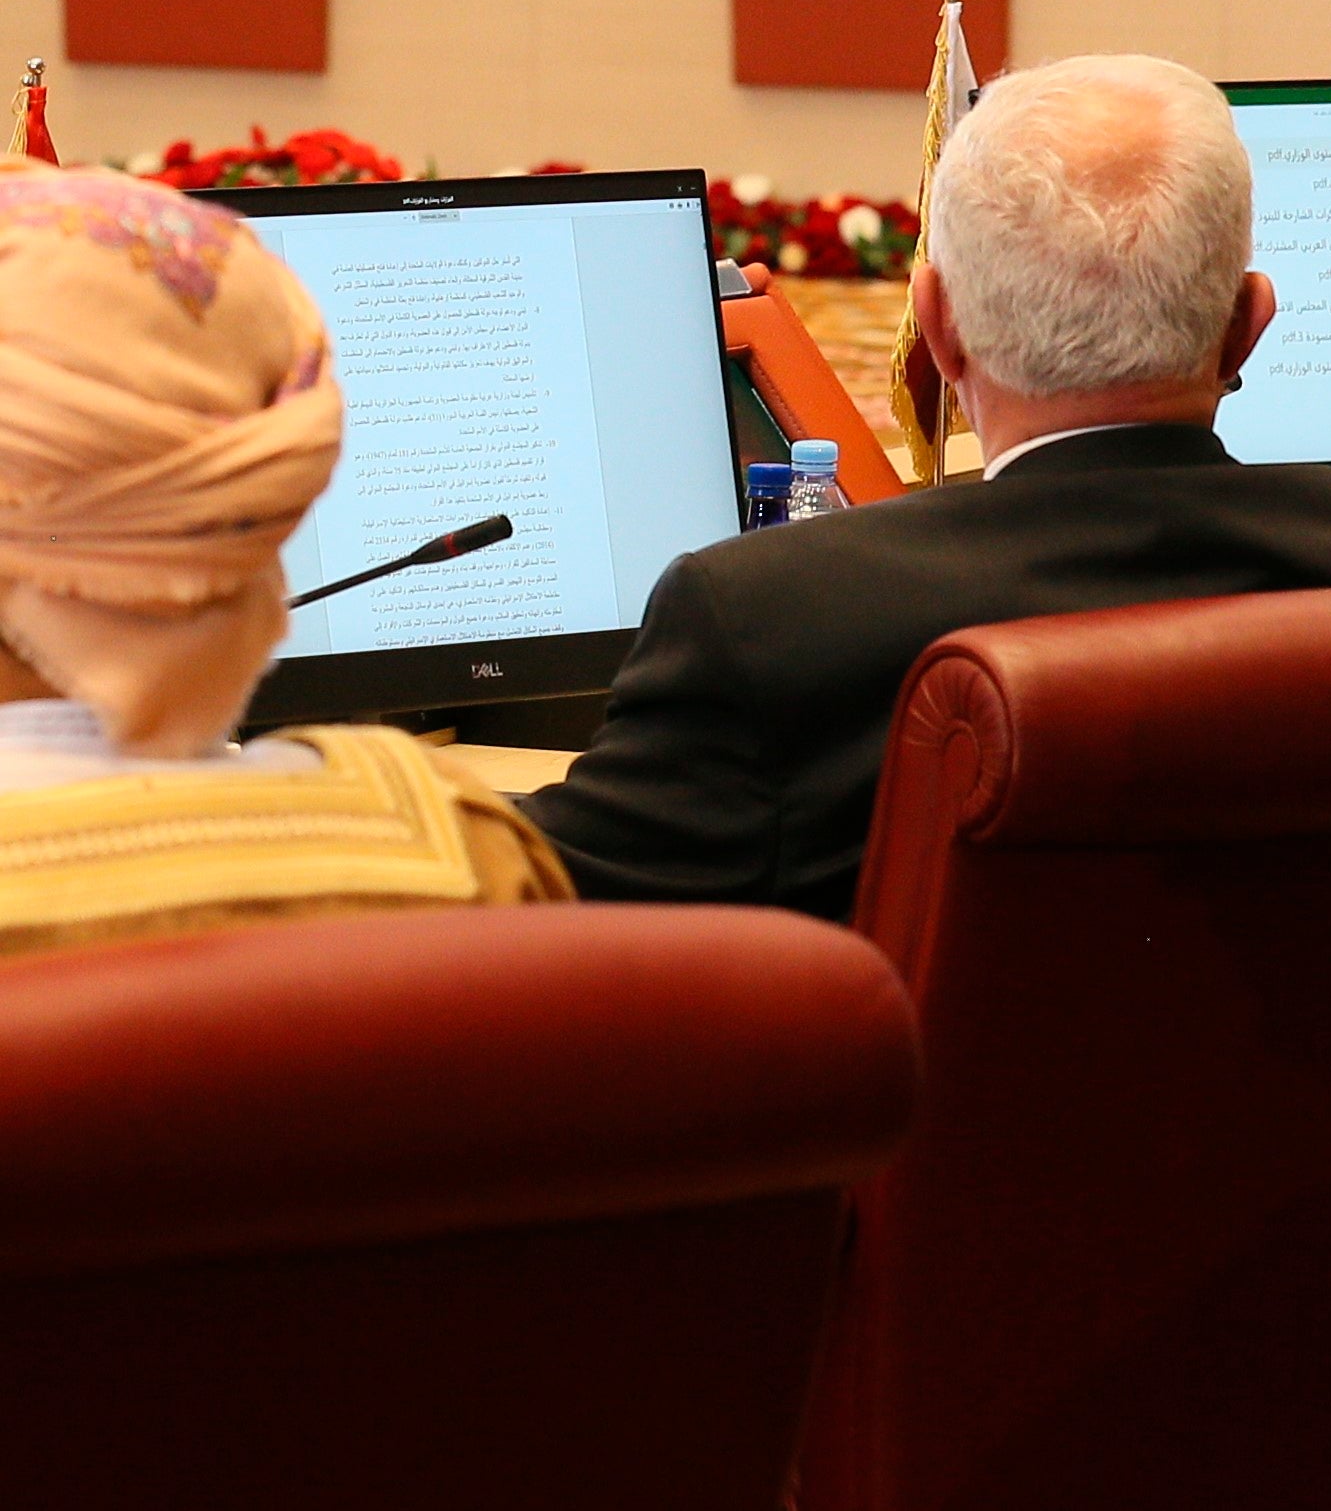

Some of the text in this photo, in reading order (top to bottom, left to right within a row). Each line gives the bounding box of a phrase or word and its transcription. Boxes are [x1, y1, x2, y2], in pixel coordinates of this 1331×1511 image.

[1301, 239, 1327, 252] العربي
[1296, 300, 1327, 315] المجلس
[472, 662, 504, 679] DELL
